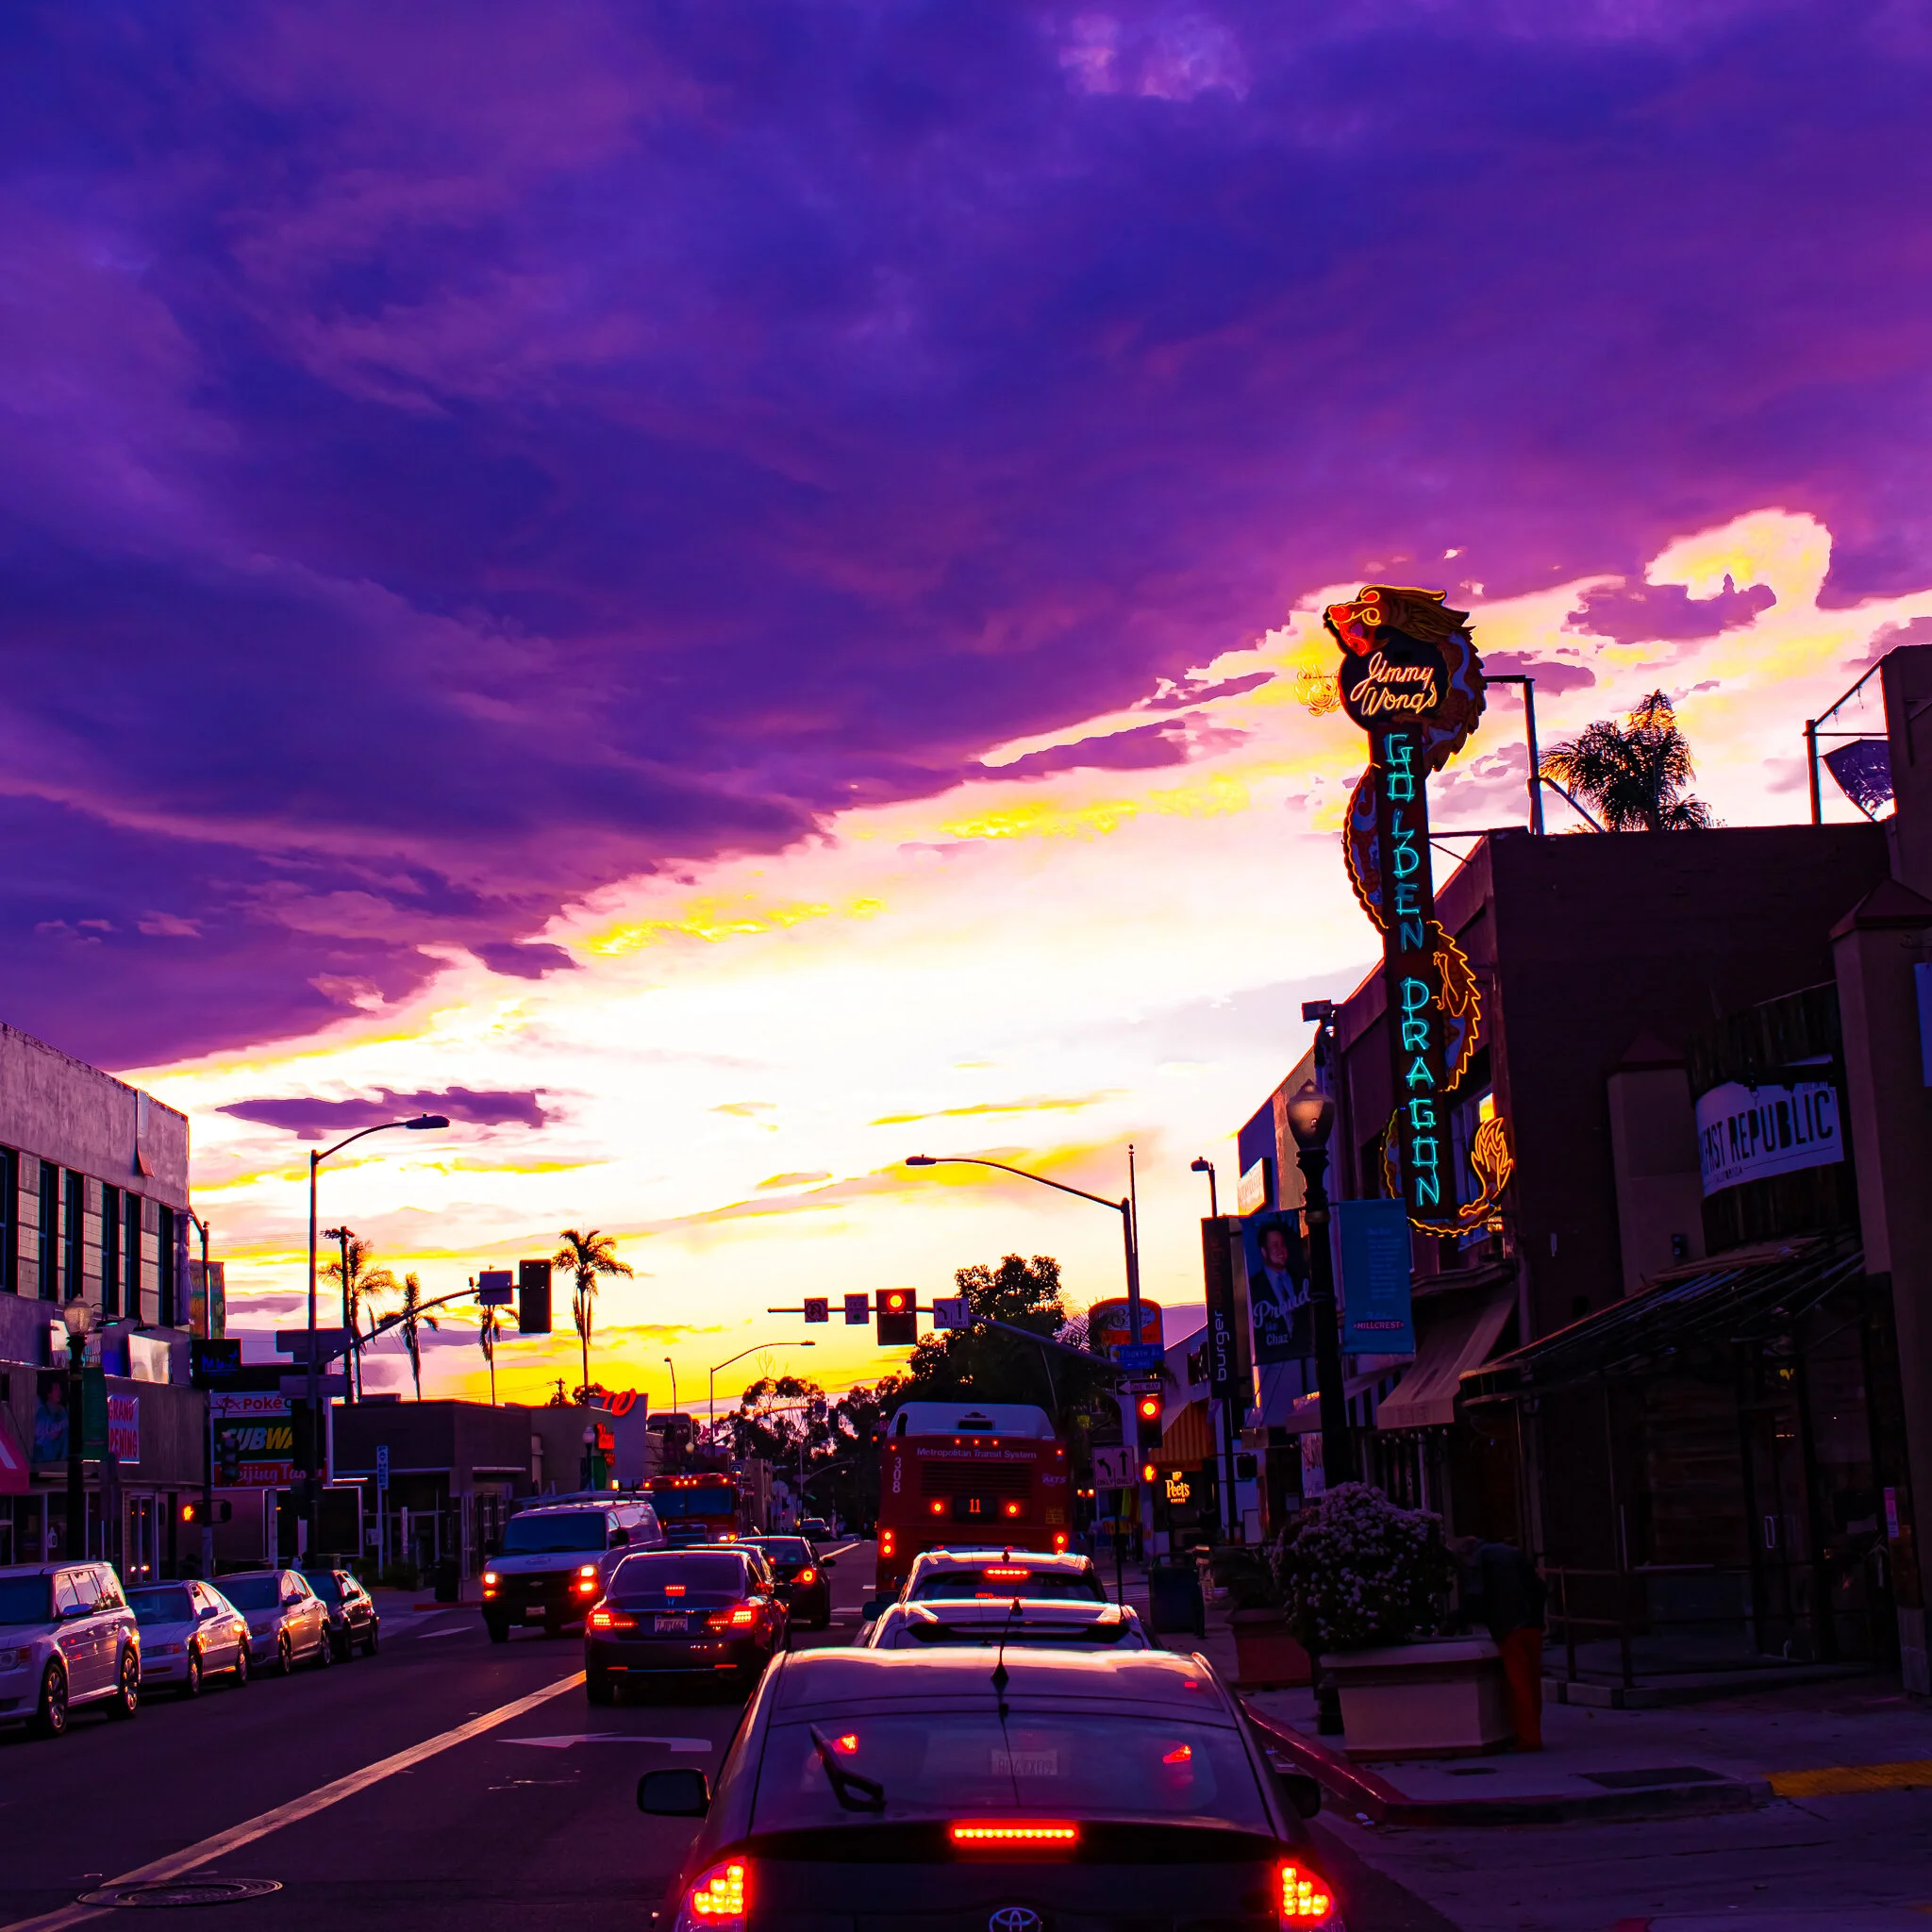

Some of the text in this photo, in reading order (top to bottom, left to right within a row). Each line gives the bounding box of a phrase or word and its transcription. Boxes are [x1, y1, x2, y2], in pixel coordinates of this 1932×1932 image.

[1350, 651, 1434, 702] Jimmy
[1383, 732, 1441, 1207] GOLDEN DRAGON
[1728, 1091, 1834, 1163] REPUBLIC
[1253, 1276, 1313, 1329] Proud
[1357, 1322, 1401, 1330] HILLCREST
[1214, 1309, 1230, 1382] burger
[1266, 1333, 1290, 1347] Chaz
[108, 1399, 134, 1422] GRAND
[243, 1396, 282, 1410] Poké
[108, 1428, 138, 1457] PENING
[916, 1446, 1037, 1460] Metropolitan Transit System
[238, 1464, 278, 1486] eijing
[891, 1457, 902, 1493] 308
[1165, 1479, 1191, 1498] Peet's
[968, 1498, 981, 1513] 11
